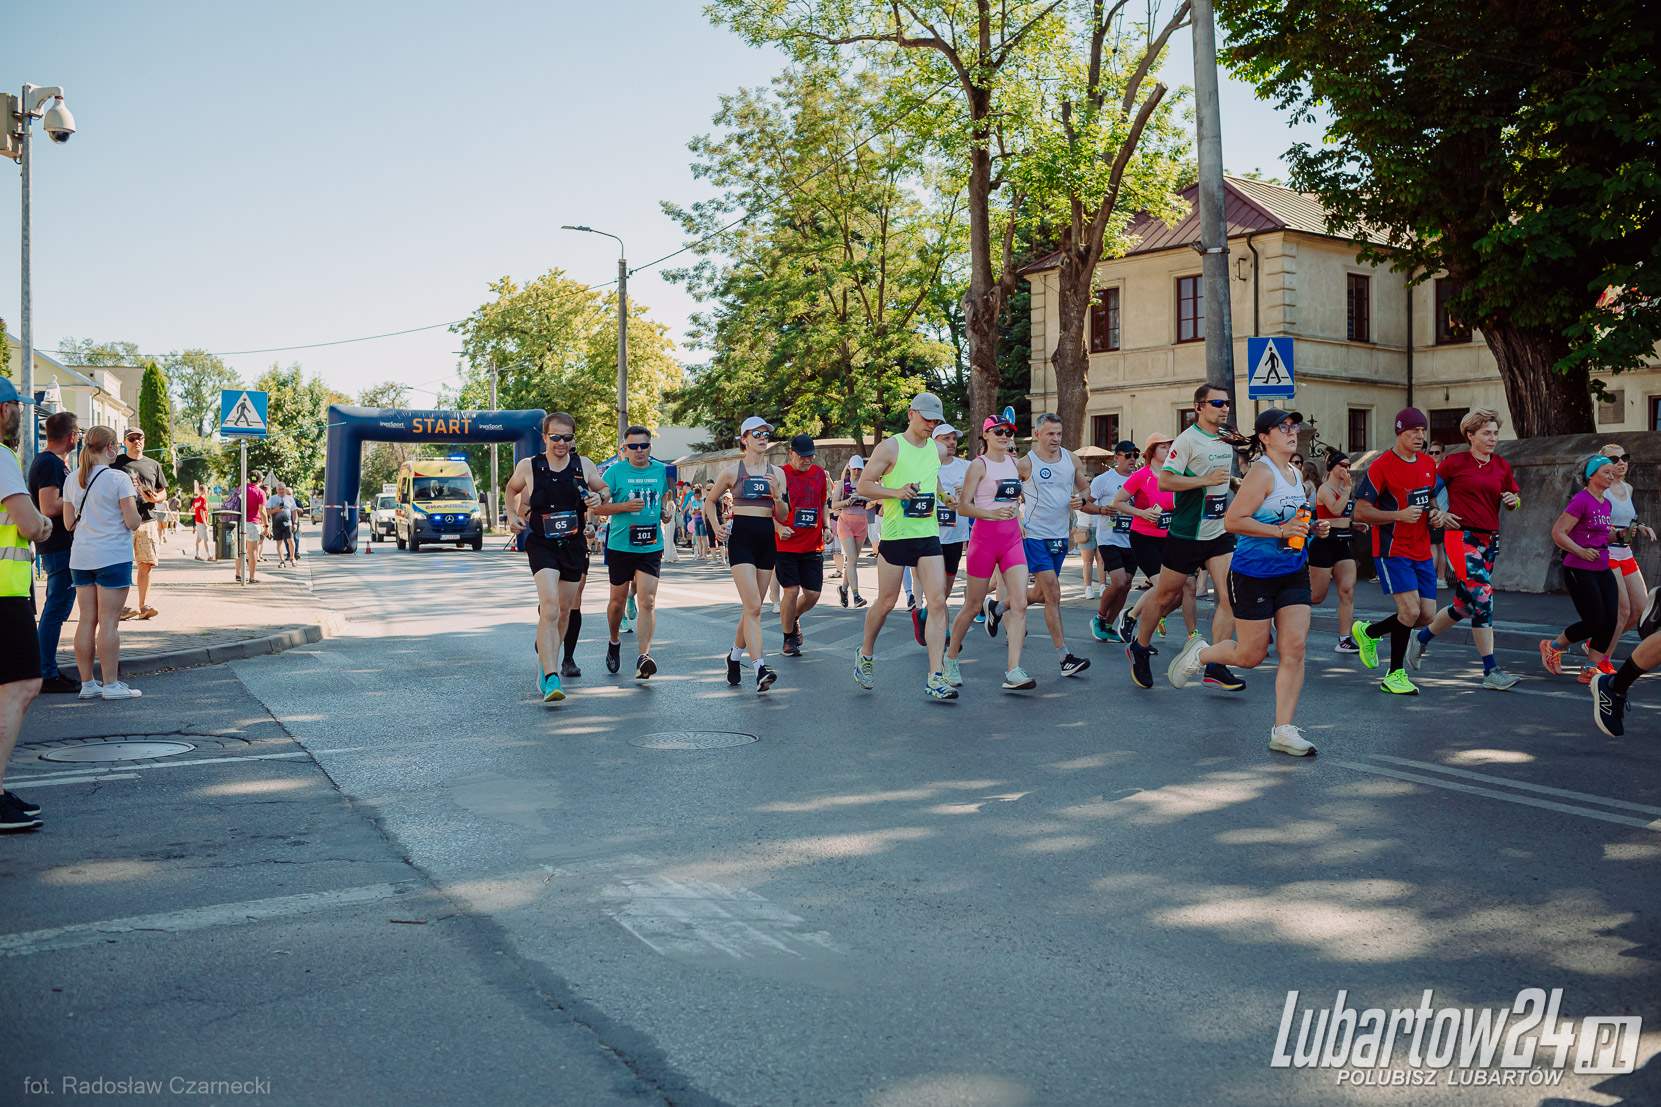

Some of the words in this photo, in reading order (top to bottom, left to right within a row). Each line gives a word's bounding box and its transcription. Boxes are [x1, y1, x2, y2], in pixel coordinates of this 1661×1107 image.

[412, 417, 472, 434] START
[753, 483, 765, 491] 30
[1005, 487, 1015, 495] 48
[1415, 495, 1429, 505] 113
[915, 502, 927, 510] 45
[1215, 503, 1224, 511] 96
[555, 520, 567, 529] 65
[637, 532, 651, 540] 101
